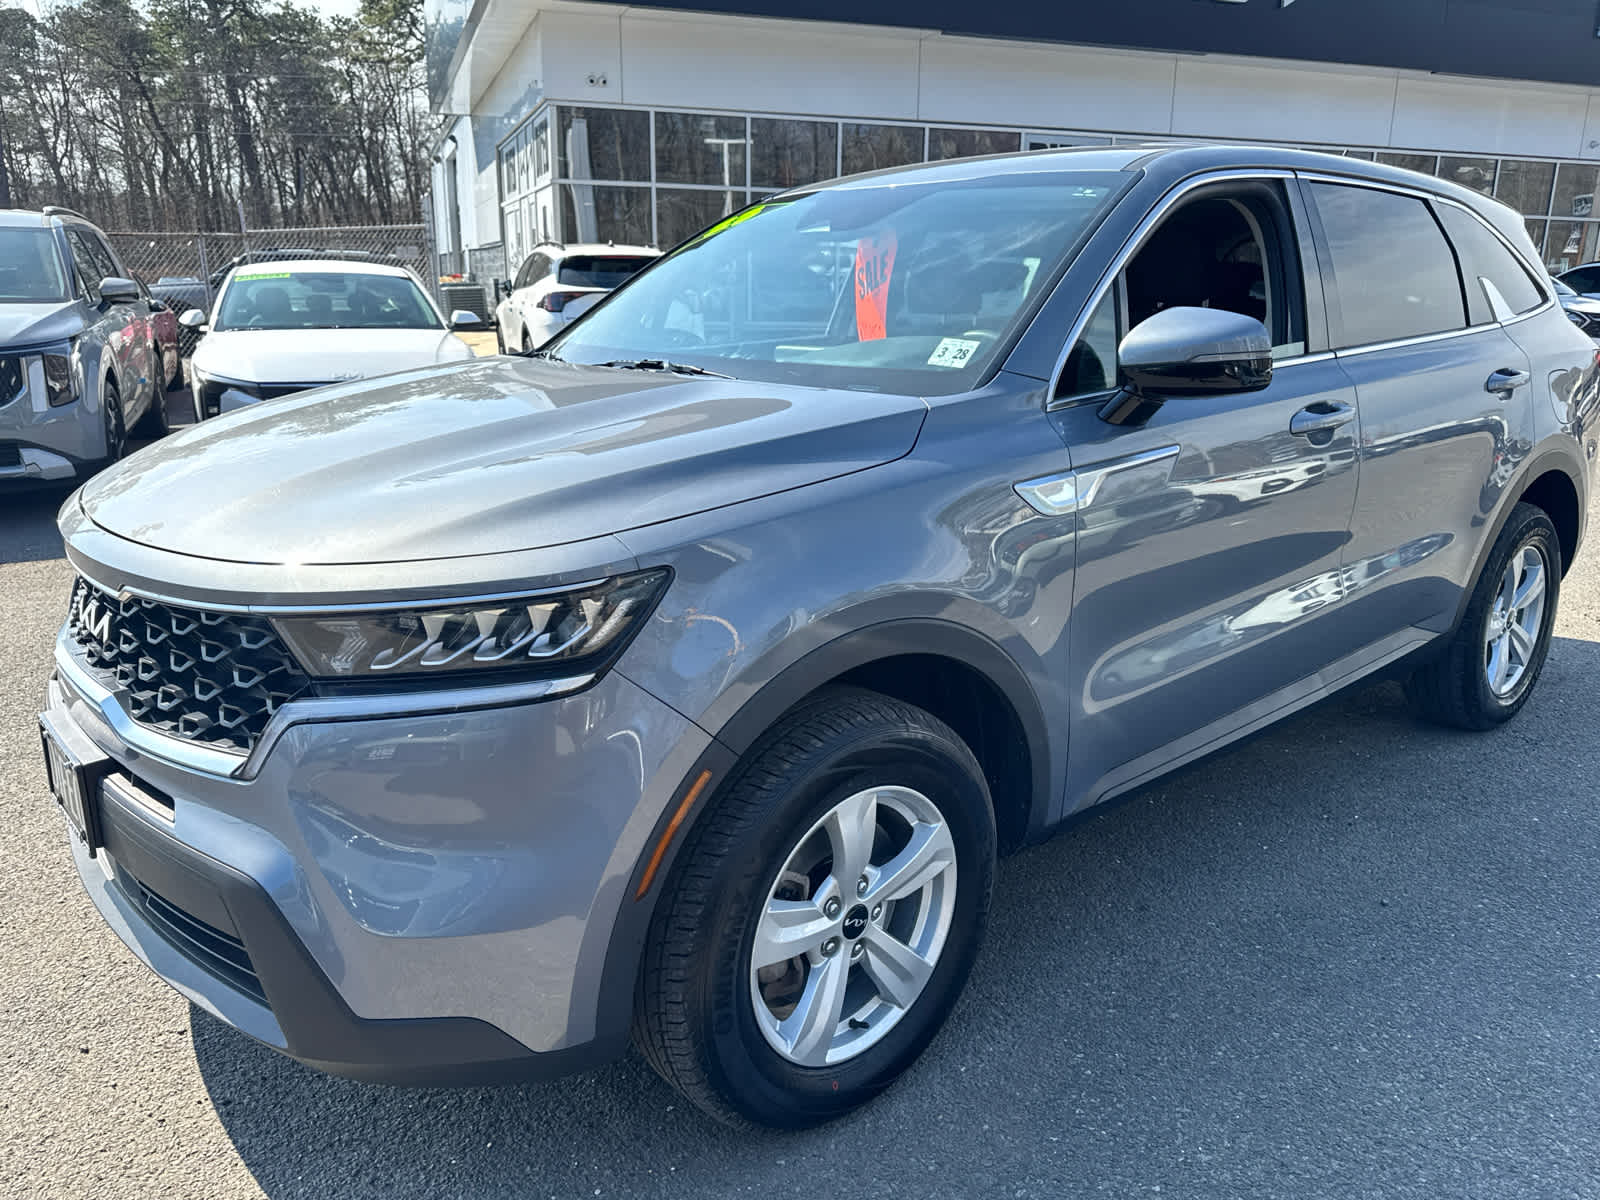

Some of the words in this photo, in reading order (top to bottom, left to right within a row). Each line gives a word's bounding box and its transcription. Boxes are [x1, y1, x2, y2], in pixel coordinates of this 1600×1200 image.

[857, 251, 889, 300] SALE
[937, 346, 949, 358] 3
[951, 348, 970, 360] 28
